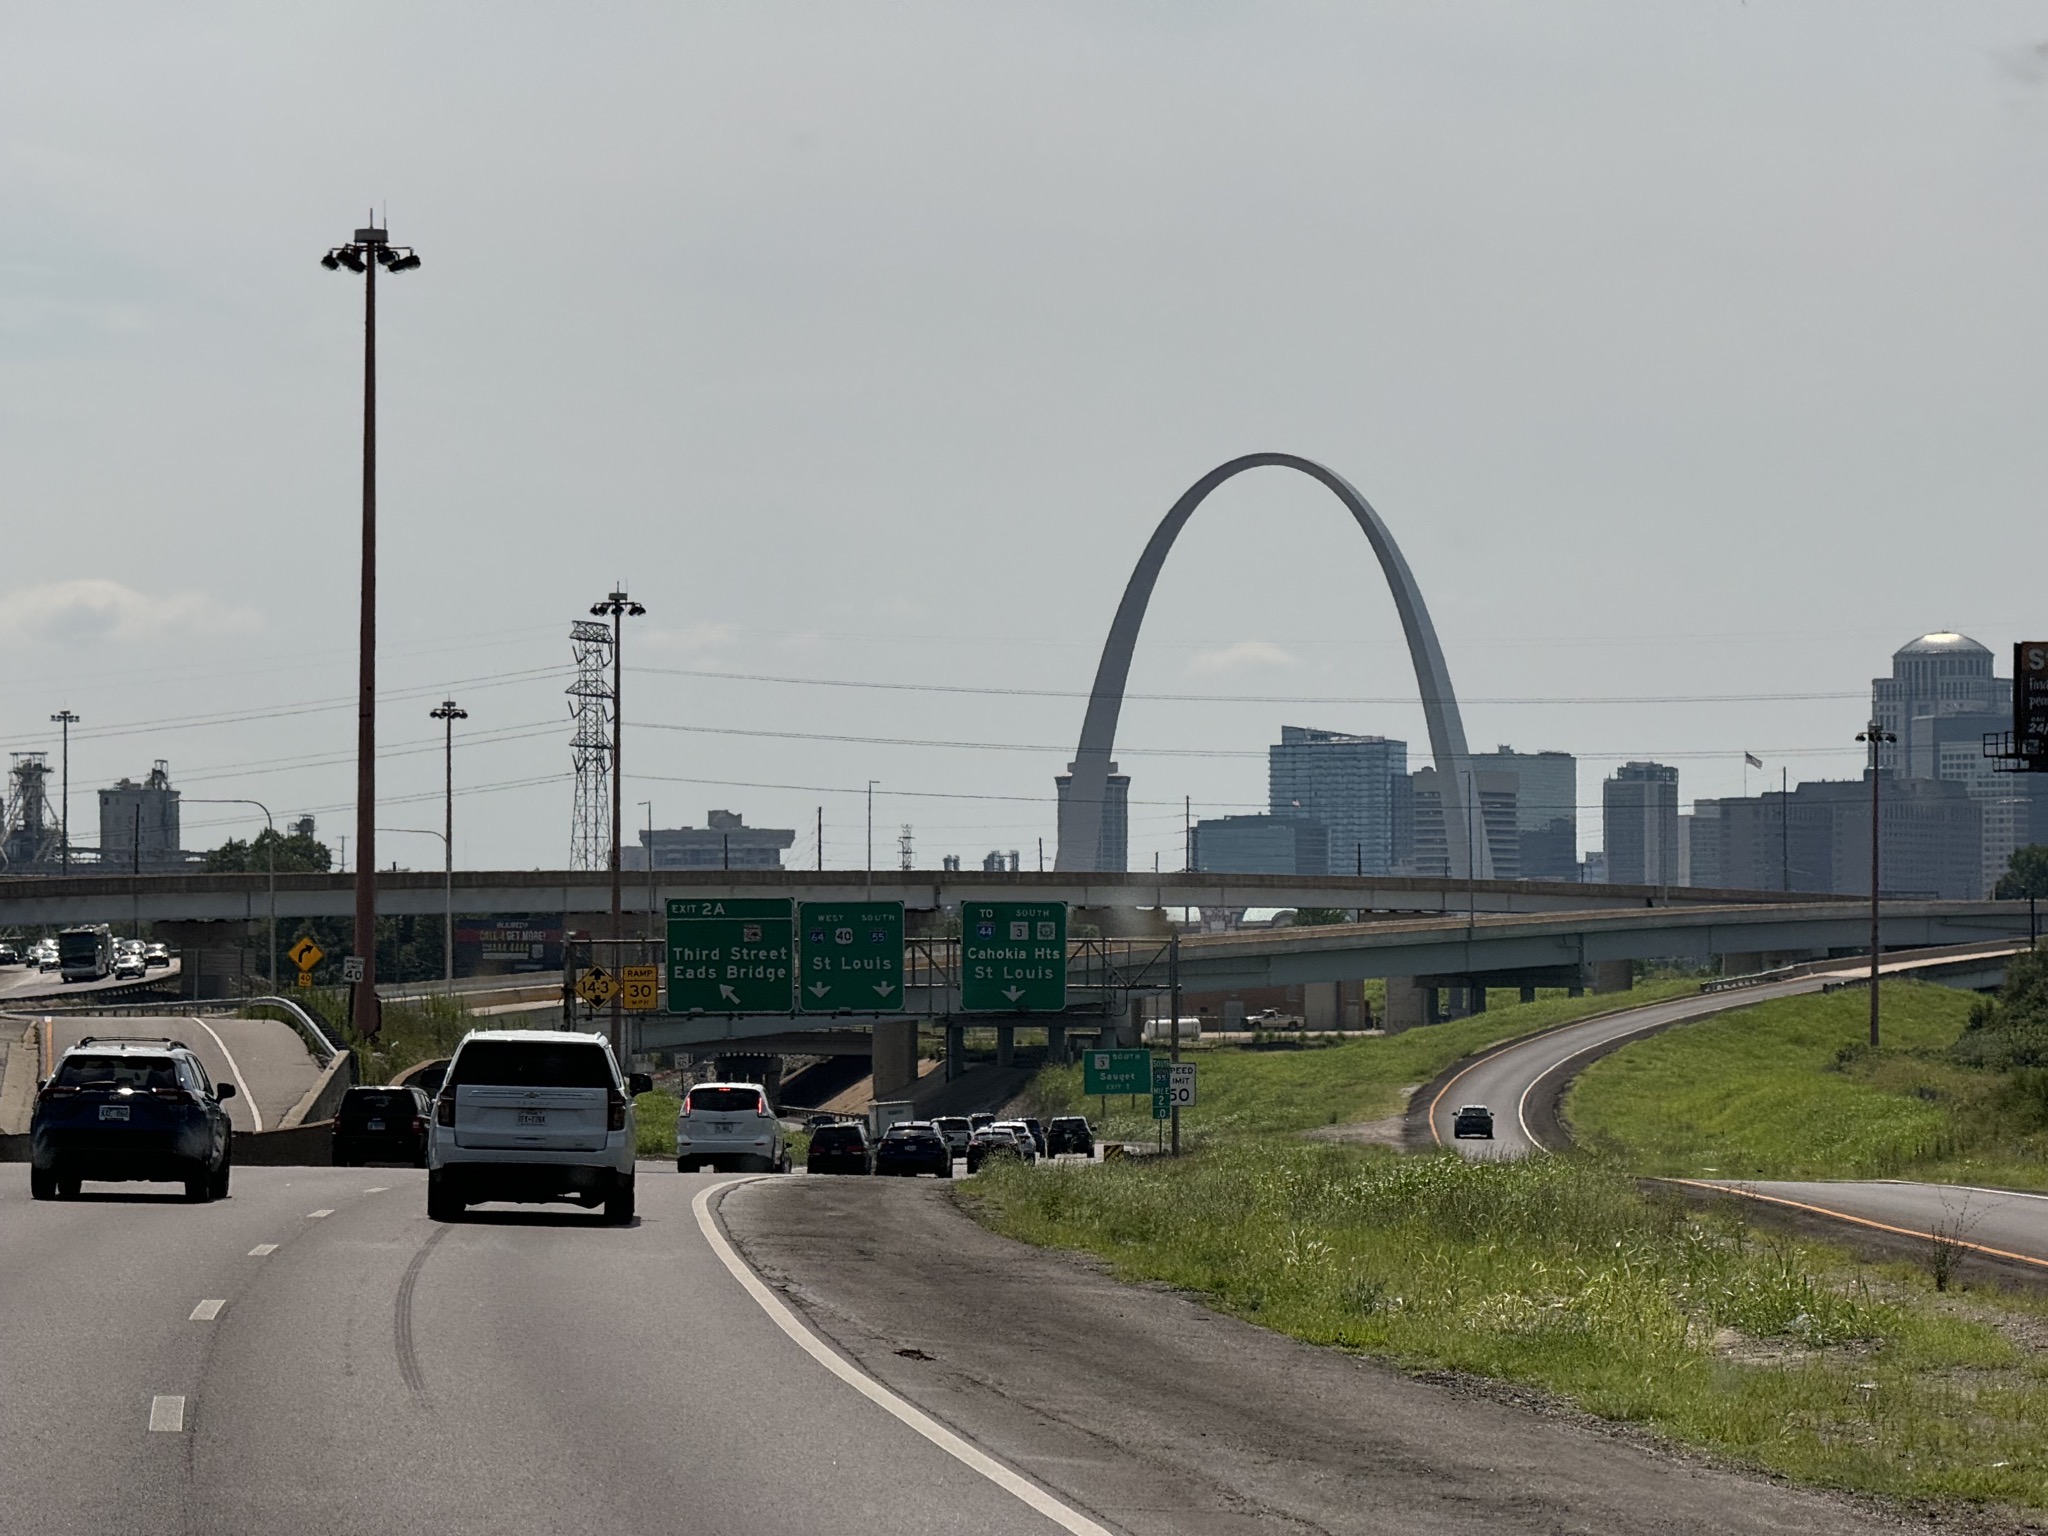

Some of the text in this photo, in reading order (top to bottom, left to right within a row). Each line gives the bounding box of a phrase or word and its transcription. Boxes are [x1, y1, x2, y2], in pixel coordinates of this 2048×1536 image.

[2028, 648, 2048, 670] S
[671, 902, 726, 915] EXIT 2A
[980, 909, 993, 918] TO
[1016, 909, 1050, 917] SOUTH
[817, 914, 844, 922] WEST
[836, 931, 852, 941] 40
[979, 927, 992, 936] 44
[1016, 928, 1023, 938] 3
[811, 933, 824, 942] 64
[872, 932, 884, 942] 55
[673, 946, 788, 960] Third Street
[968, 947, 1060, 959] Cahokia Hts
[813, 956, 892, 970] St Louis
[345, 970, 362, 980] 40
[627, 969, 653, 977] RAMP
[674, 965, 786, 982] Eads Bridge
[974, 966, 1054, 979] St Louis
[582, 981, 609, 994] 14-3
[629, 985, 651, 998] 30
[1100, 1059, 1105, 1067] 3
[1100, 1073, 1136, 1082] Sauget
[1171, 1077, 1190, 1085] IMIT
[1153, 1087, 1170, 1095] MILE
[1170, 1088, 1190, 1102] 50
[1158, 1096, 1165, 1105] 2
